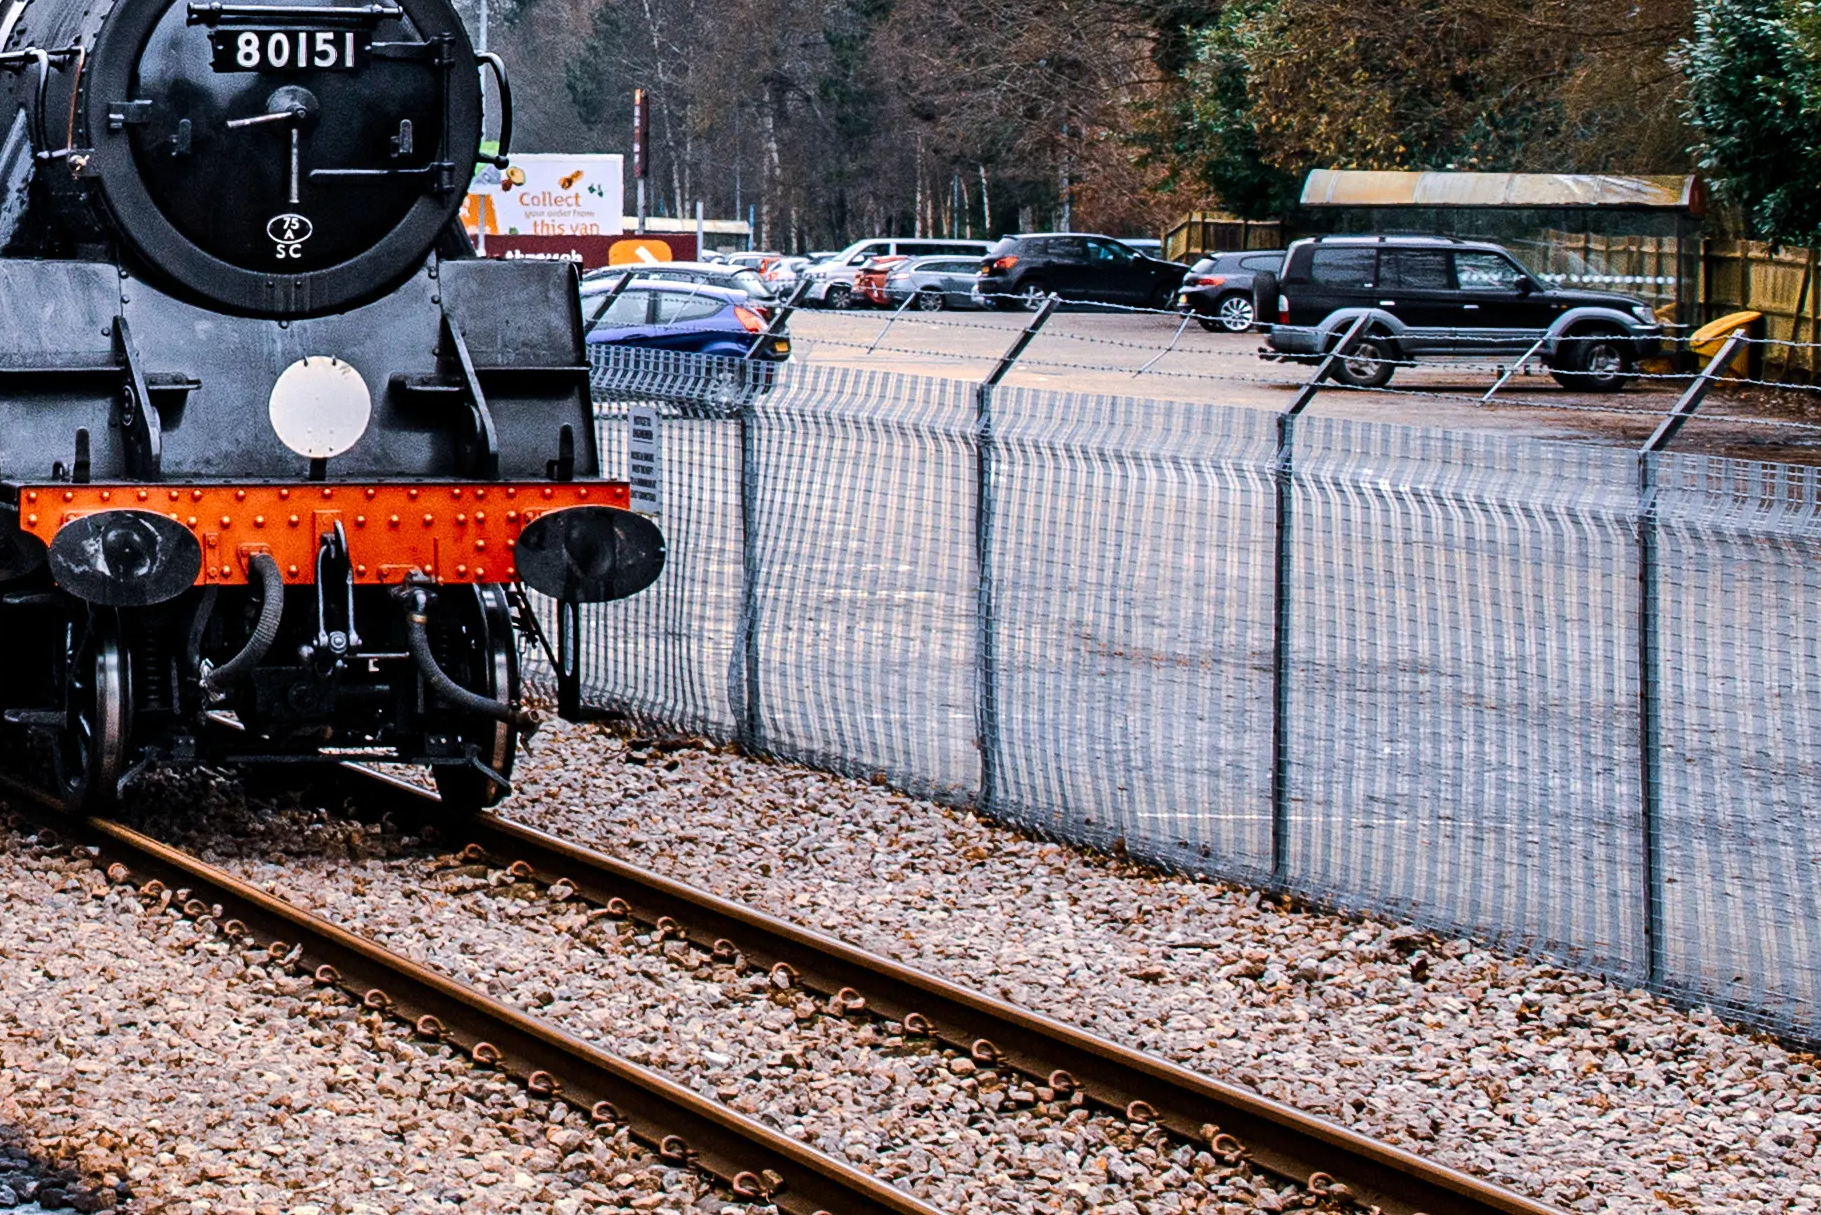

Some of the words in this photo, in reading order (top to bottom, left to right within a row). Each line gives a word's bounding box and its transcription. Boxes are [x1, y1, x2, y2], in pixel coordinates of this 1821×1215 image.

[236, 31, 355, 68] 80151
[519, 191, 582, 207] Collect
[524, 210, 545, 219] your
[547, 208, 571, 218] order
[572, 208, 595, 217] from
[282, 217, 300, 230] 75
[533, 219, 566, 236] this
[569, 223, 601, 236] van
[284, 229, 295, 240] A
